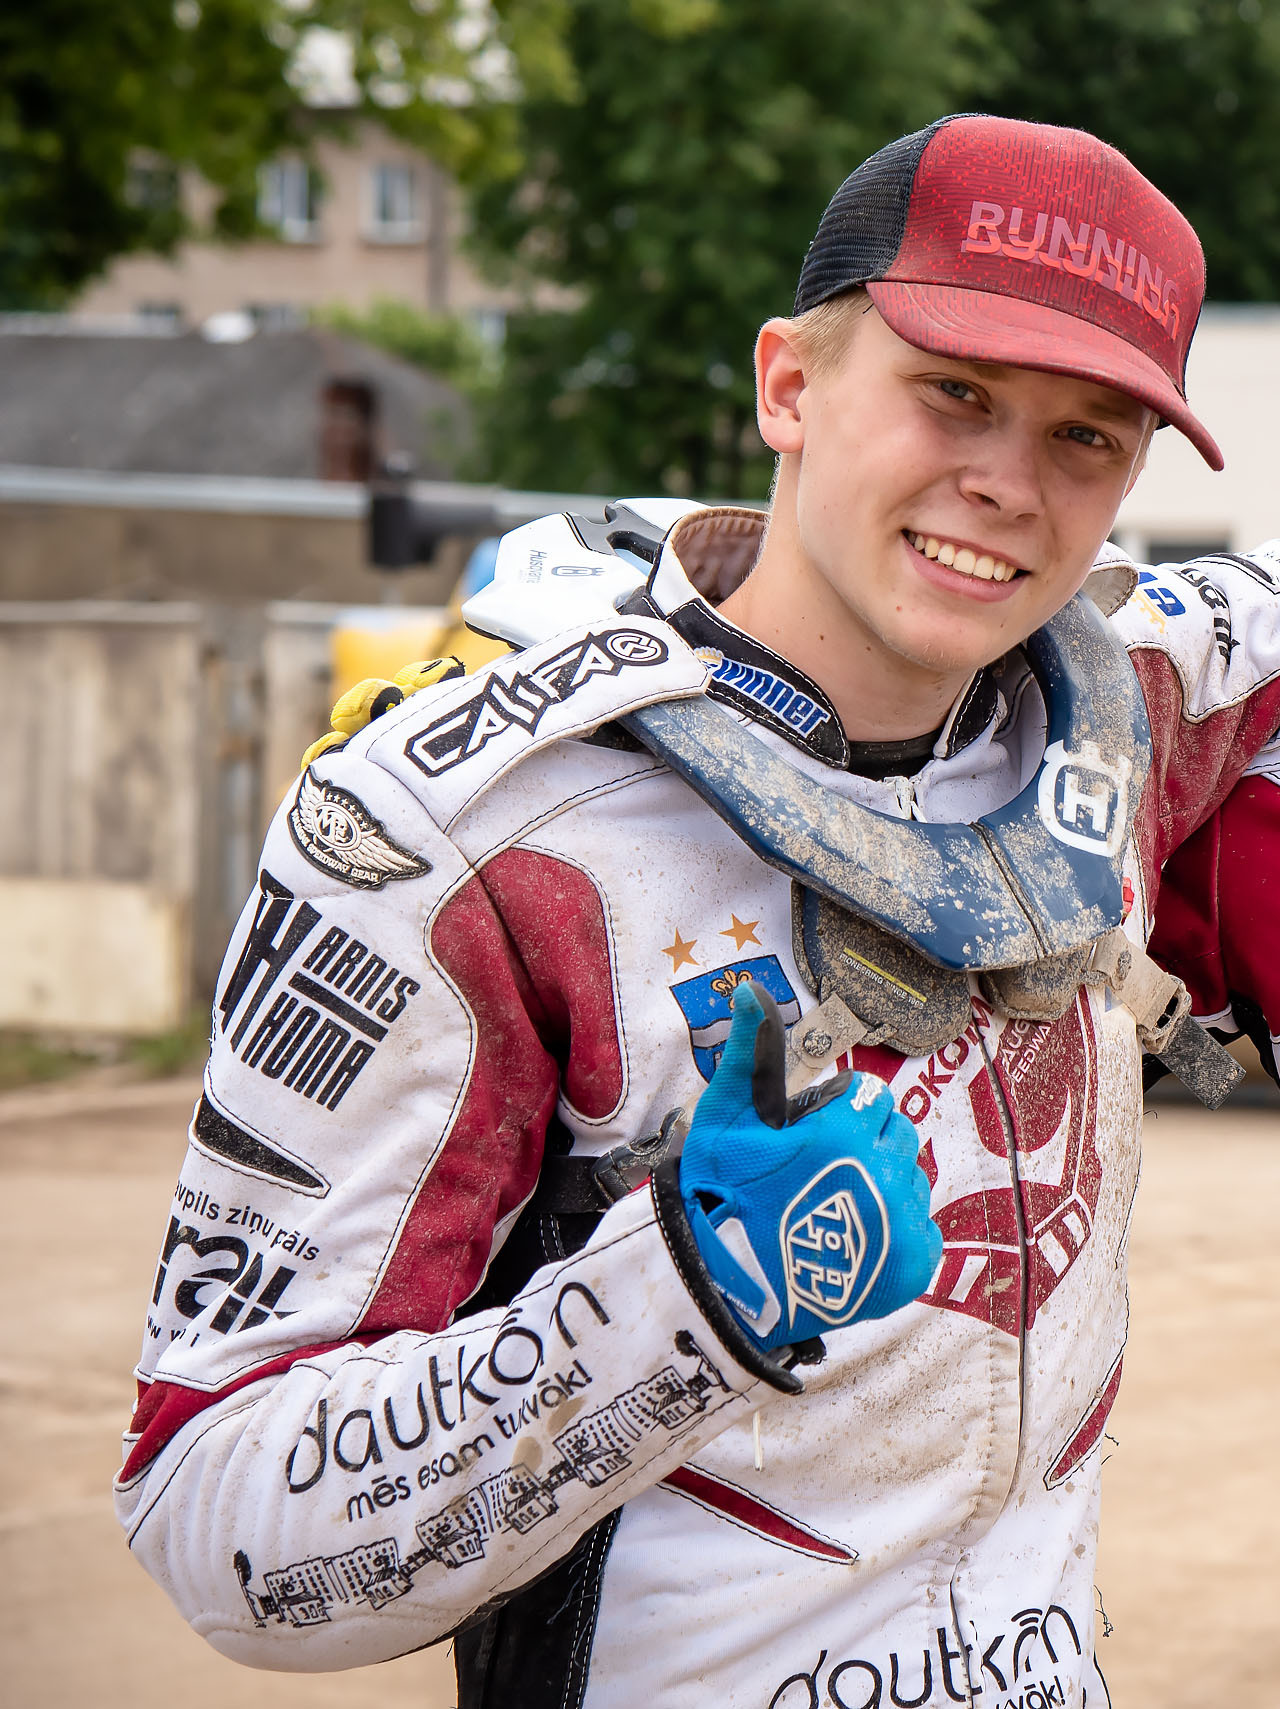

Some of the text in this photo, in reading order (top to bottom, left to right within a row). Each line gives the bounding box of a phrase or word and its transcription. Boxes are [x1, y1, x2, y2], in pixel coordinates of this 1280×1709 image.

[306, 843, 350, 874] SPEEDWAY
[350, 867, 379, 882] GEAR
[345, 1473, 412, 1523] mēs
[416, 1433, 496, 1490] esam
